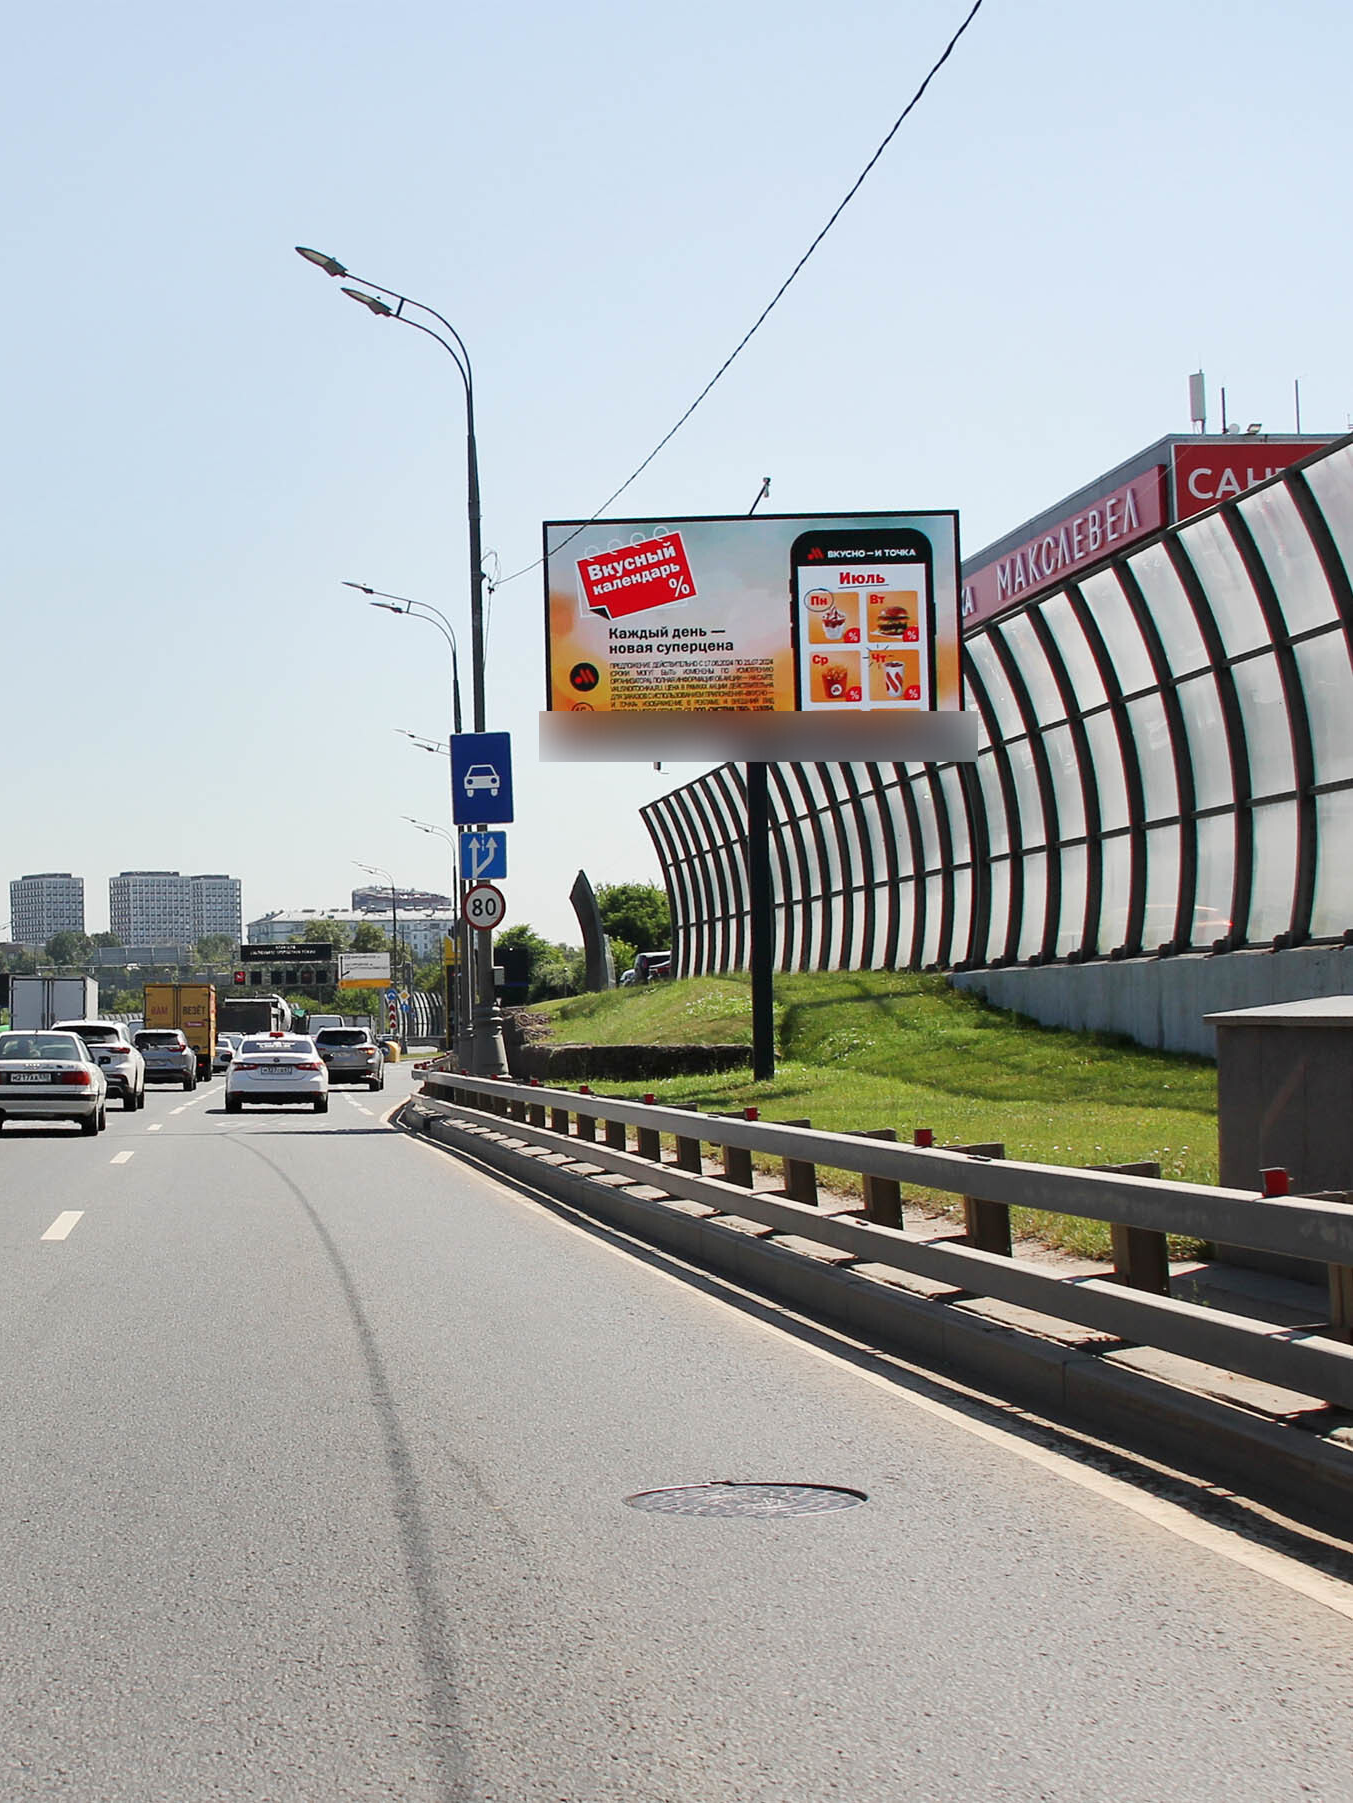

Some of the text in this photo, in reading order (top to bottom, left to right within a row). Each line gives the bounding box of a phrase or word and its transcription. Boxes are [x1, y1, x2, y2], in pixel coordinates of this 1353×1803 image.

[1188, 467, 1286, 499] САН
[827, 549, 866, 559] ВКУСНО
[884, 548, 916, 557] ТОЧКА
[587, 542, 677, 581] Вкусный
[592, 562, 681, 595] календарь
[839, 572, 886, 585] Июль
[668, 576, 690, 597] %
[810, 595, 828, 606] Пн
[869, 594, 885, 604] Вт
[608, 627, 669, 640] Каждый
[672, 627, 707, 639] день
[609, 641, 734, 655] новая суперцена
[812, 655, 829, 665] Ср
[871, 654, 887, 663] Чт
[471, 898, 496, 917] 80
